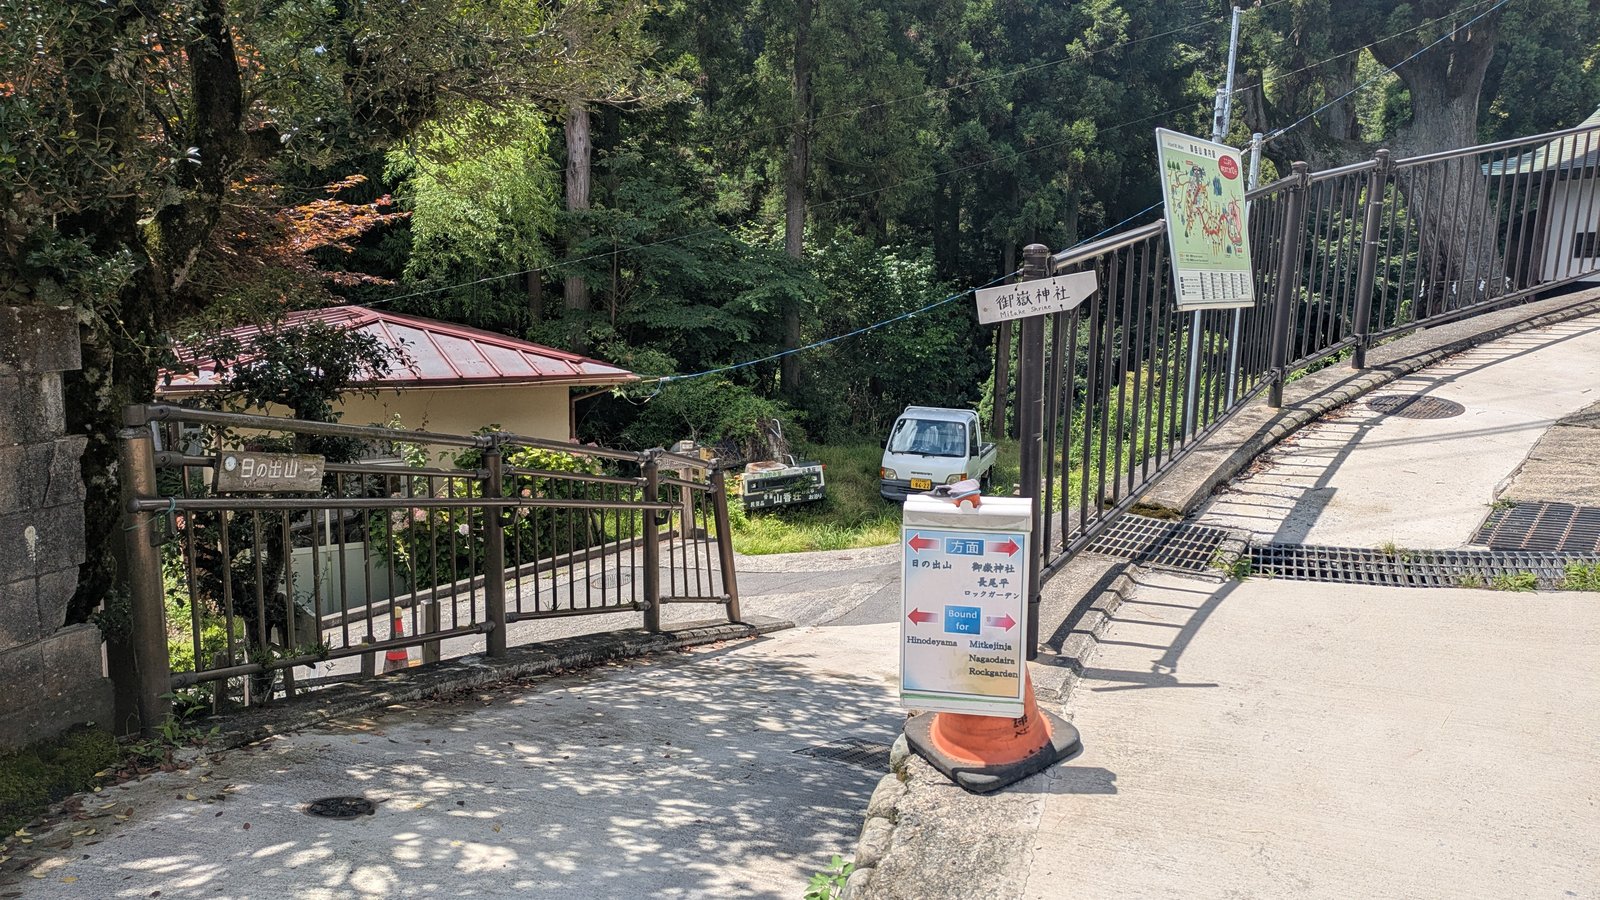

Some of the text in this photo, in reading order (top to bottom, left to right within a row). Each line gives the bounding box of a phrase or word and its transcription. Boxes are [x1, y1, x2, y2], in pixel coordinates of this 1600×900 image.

[995, 285, 1070, 310] 御嶽神社
[999, 309, 1026, 318] Mitake
[241, 458, 298, 478] 日の出山
[773, 491, 802, 504] 山香荘
[950, 540, 979, 554] 方面
[912, 559, 952, 570] 日の出山
[971, 562, 1015, 573] 御嶽神社
[977, 577, 1009, 588] 長尾平
[964, 590, 1020, 600] ロックガーデン
[949, 609, 977, 619] Bound
[956, 622, 970, 631] for
[907, 635, 958, 647] Hinodeyama
[969, 640, 1012, 651] Mitkejinja
[969, 654, 1015, 665] Nagaodaira
[969, 667, 1018, 679] Rockgarden
